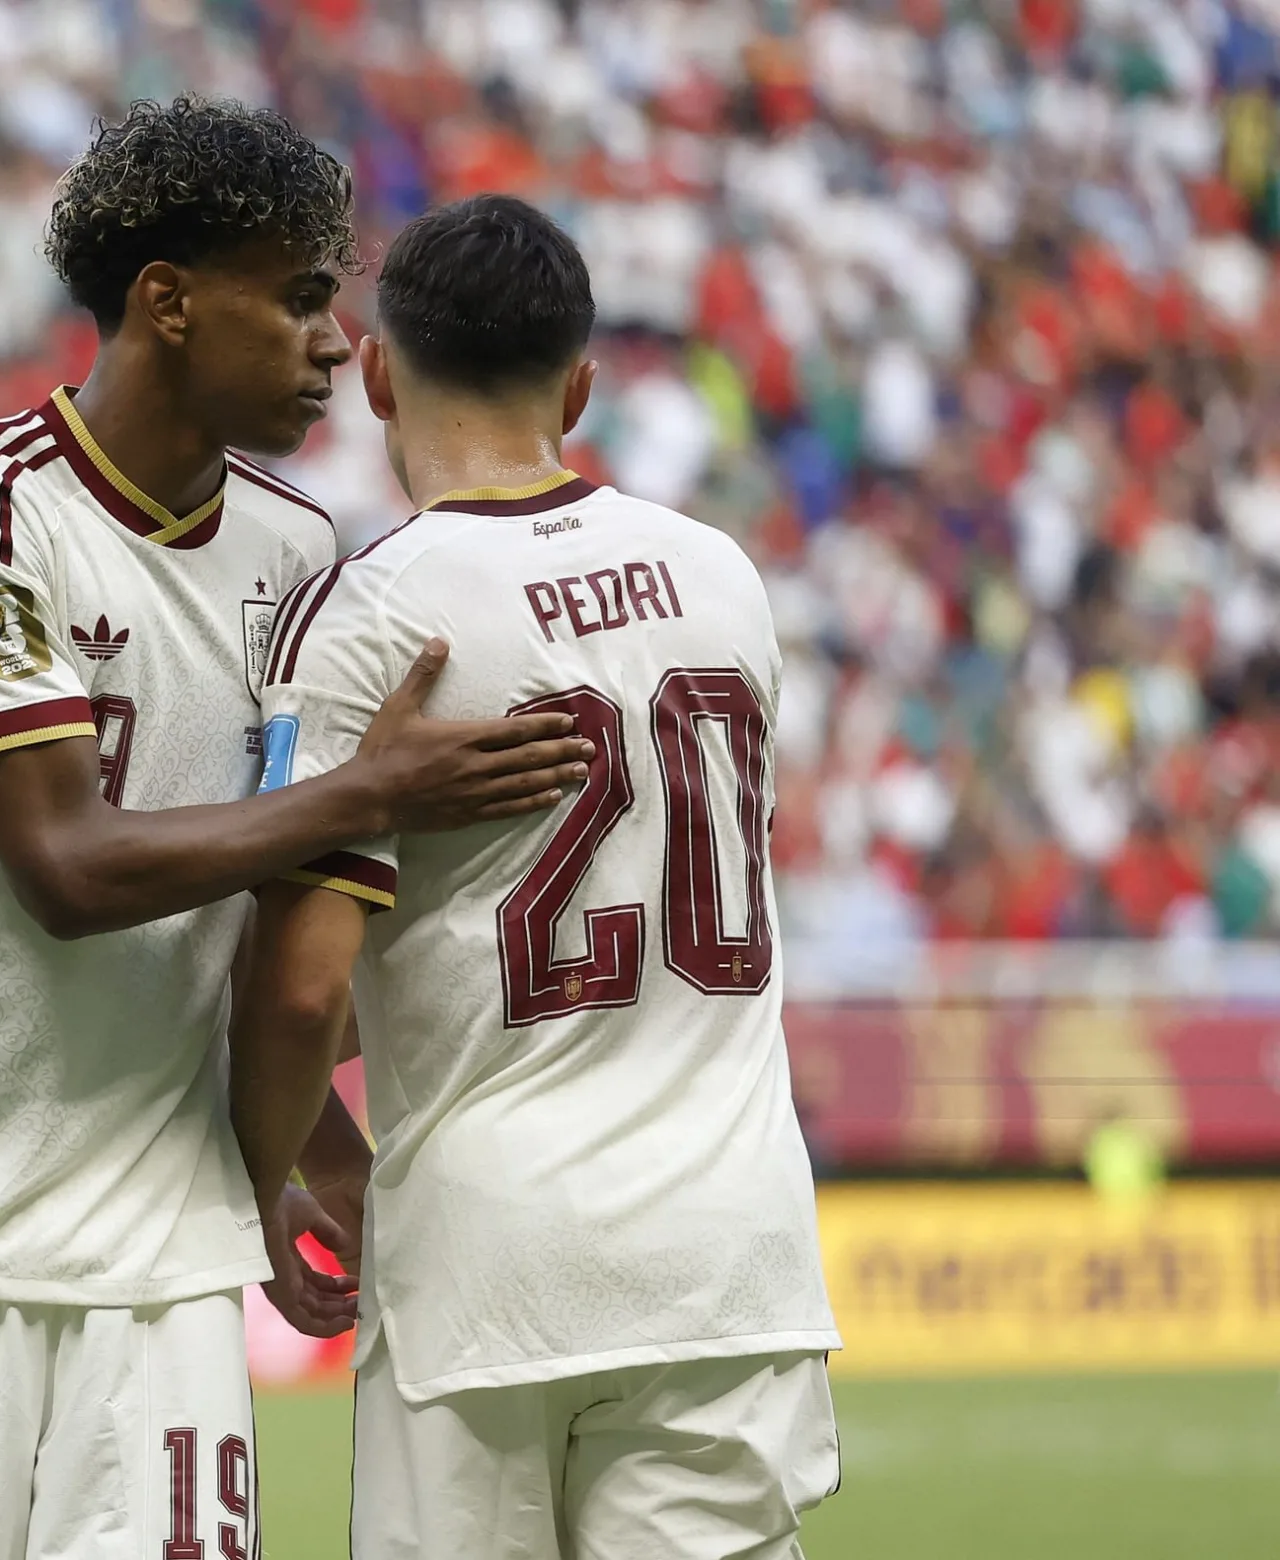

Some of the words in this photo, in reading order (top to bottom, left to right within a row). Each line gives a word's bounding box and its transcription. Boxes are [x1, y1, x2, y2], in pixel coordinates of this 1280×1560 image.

[532, 516, 582, 540] España
[523, 561, 684, 643] PEDRI
[89, 692, 138, 809] 9
[496, 667, 774, 1029] 20
[163, 1427, 249, 1560] 19
